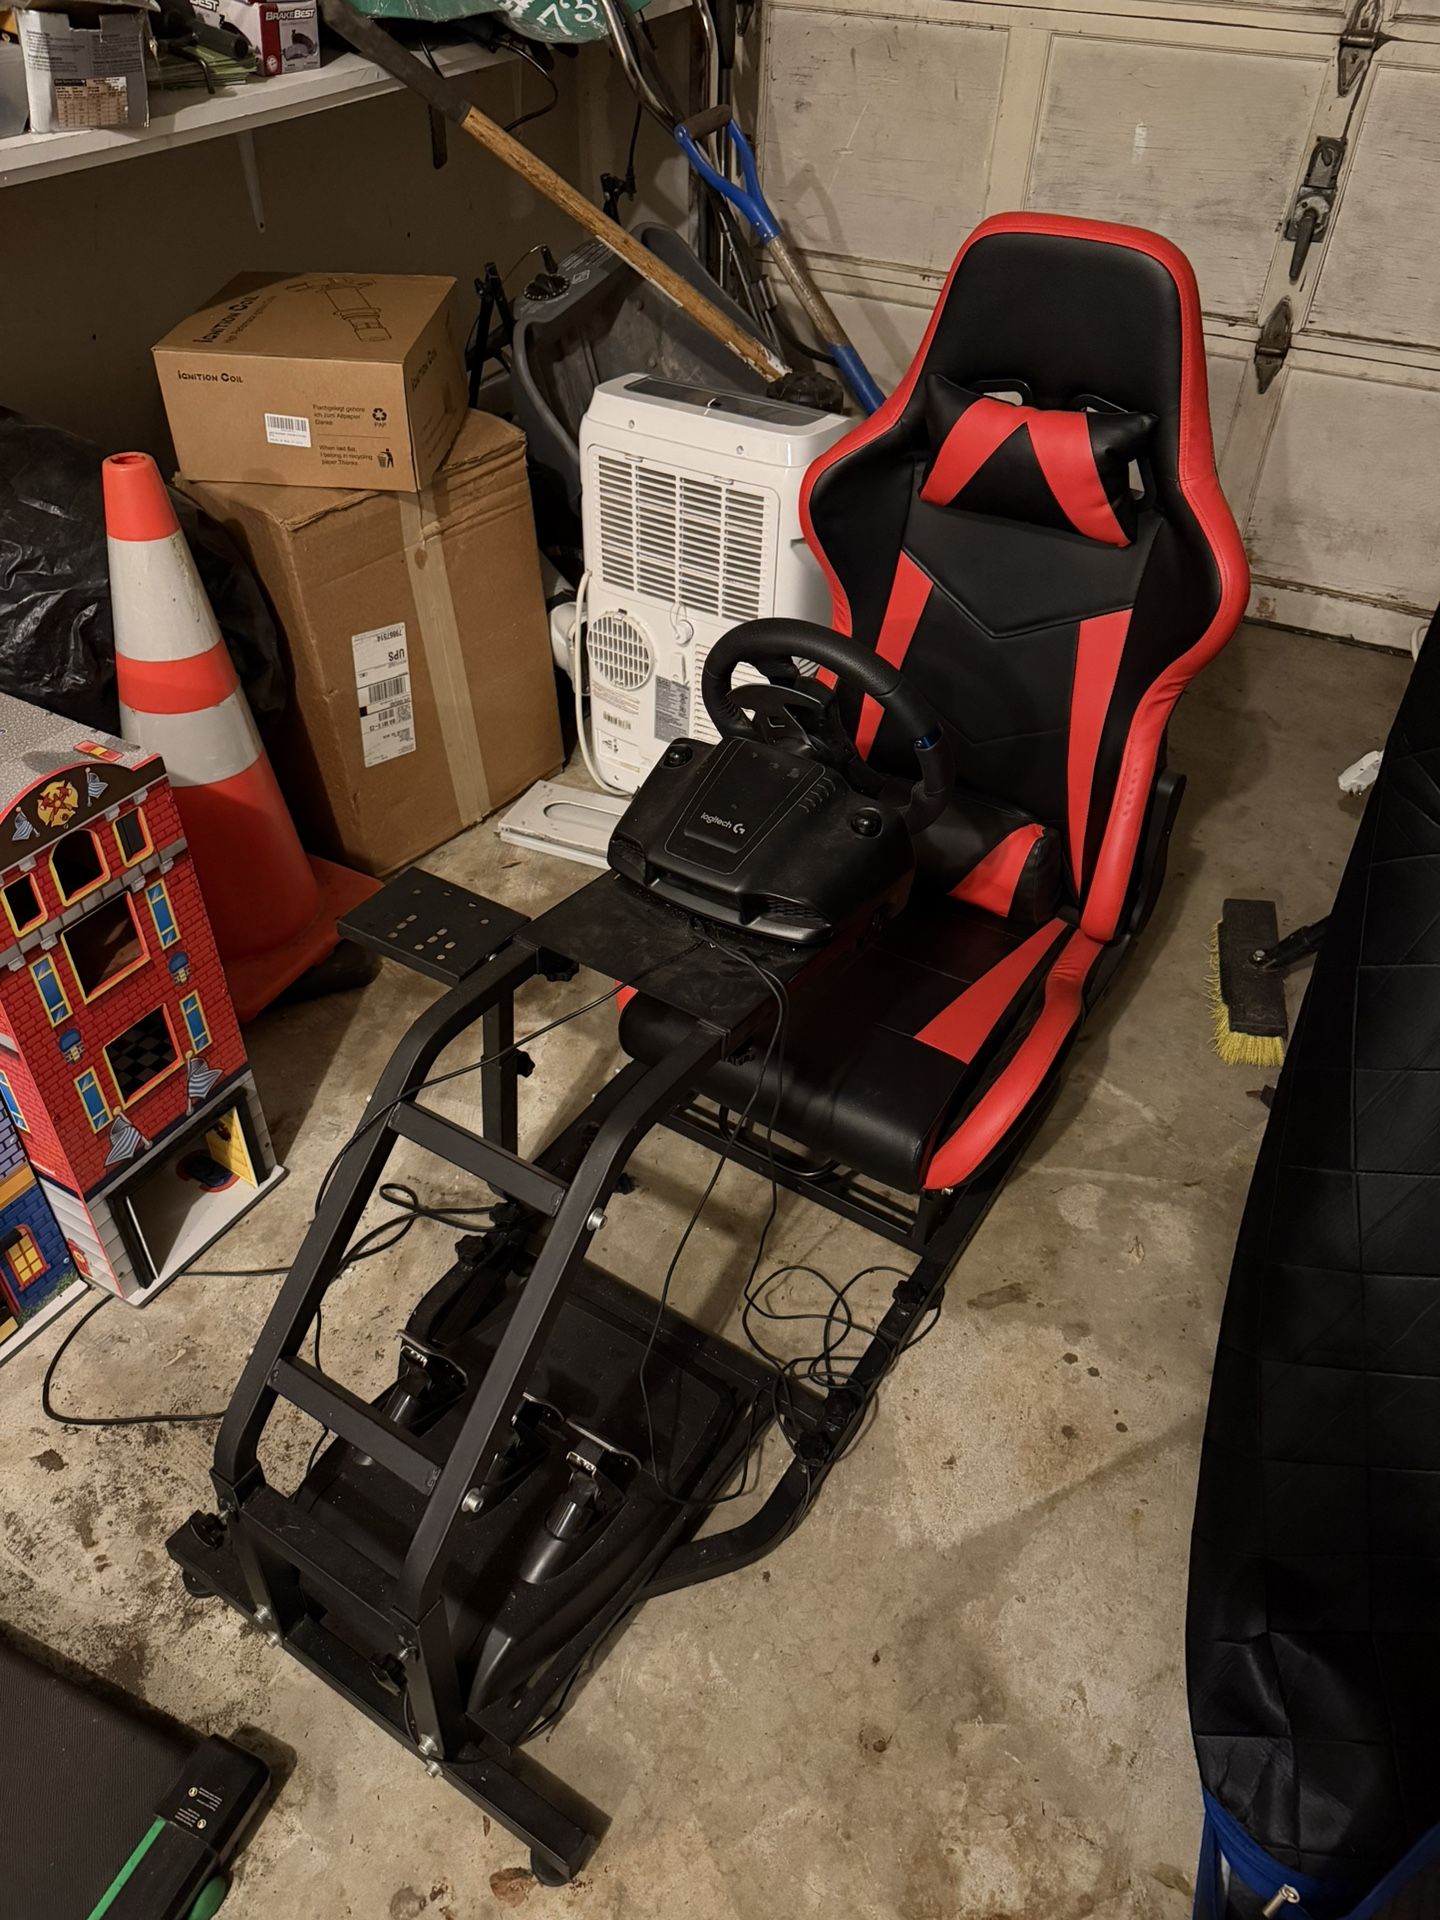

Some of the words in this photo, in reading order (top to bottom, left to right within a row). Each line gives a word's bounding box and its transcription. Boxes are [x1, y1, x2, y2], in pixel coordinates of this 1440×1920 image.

[265, 8, 315, 21] BRAKEBEST
[177, 369, 218, 382] IGNITION
[220, 372, 244, 384] COIL
[388, 648, 406, 662] UPS
[700, 812, 732, 829] logitech
